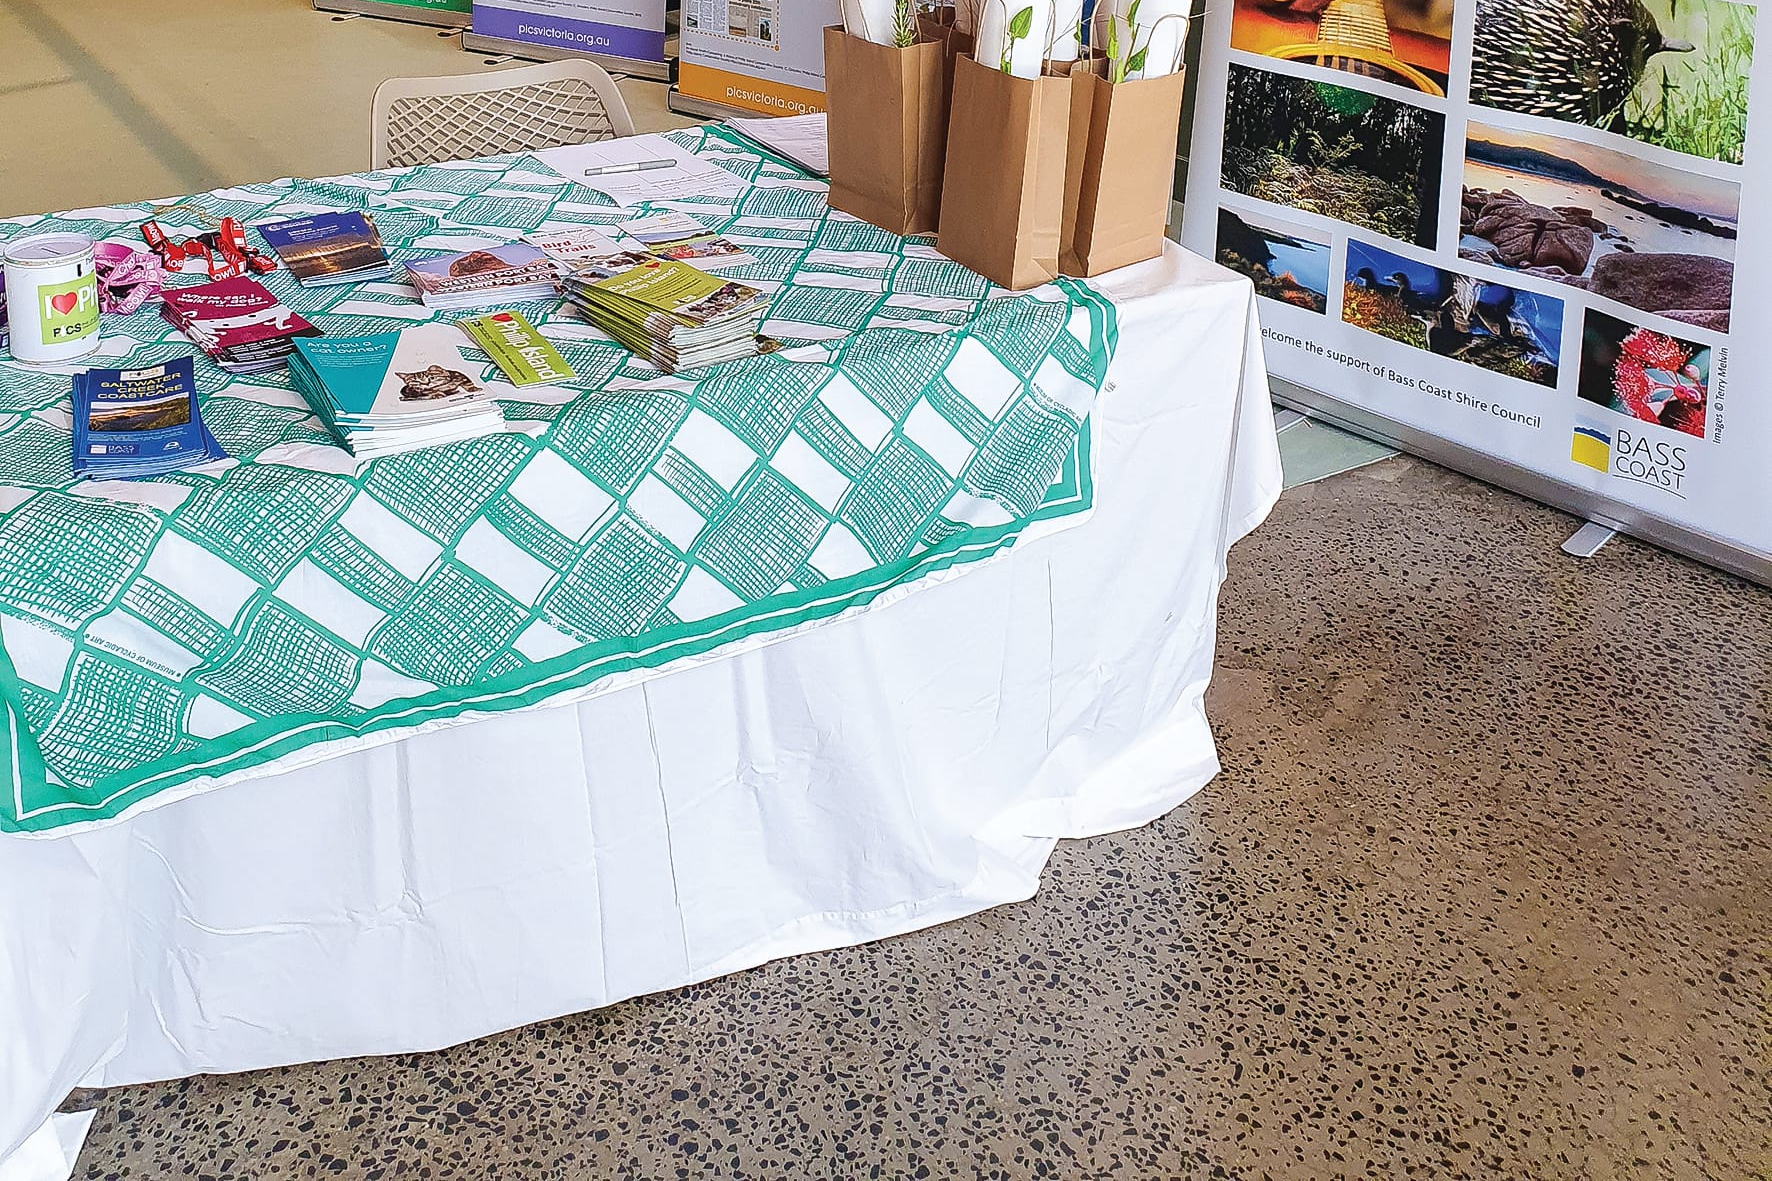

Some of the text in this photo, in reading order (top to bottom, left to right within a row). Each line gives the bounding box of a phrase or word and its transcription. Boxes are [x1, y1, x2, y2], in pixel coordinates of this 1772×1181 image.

[518, 23, 610, 46] picsvictoria.org.au
[542, 240, 571, 249] Bird
[556, 244, 596, 254] Trails
[495, 266, 527, 278] PORT
[45, 295, 52, 319] I
[494, 321, 530, 347] Phillip
[337, 344, 387, 353] owner?
[519, 346, 565, 380] Island
[1718, 347, 1729, 376] Melvin
[101, 372, 181, 387] SALTWATER
[1260, 325, 1541, 429] elcome the support of Bass Coast Shire Council
[97, 384, 183, 399] COASTCARE
[118, 383, 165, 393] CREEK
[1719, 376, 1728, 401] Terry
[1713, 413, 1724, 444] Images
[1617, 429, 1687, 471] BASS
[1615, 456, 1685, 489] COAST
[91, 636, 104, 645] ART
[104, 642, 137, 658] CYCLADIC
[146, 659, 176, 676] MUSEUM
